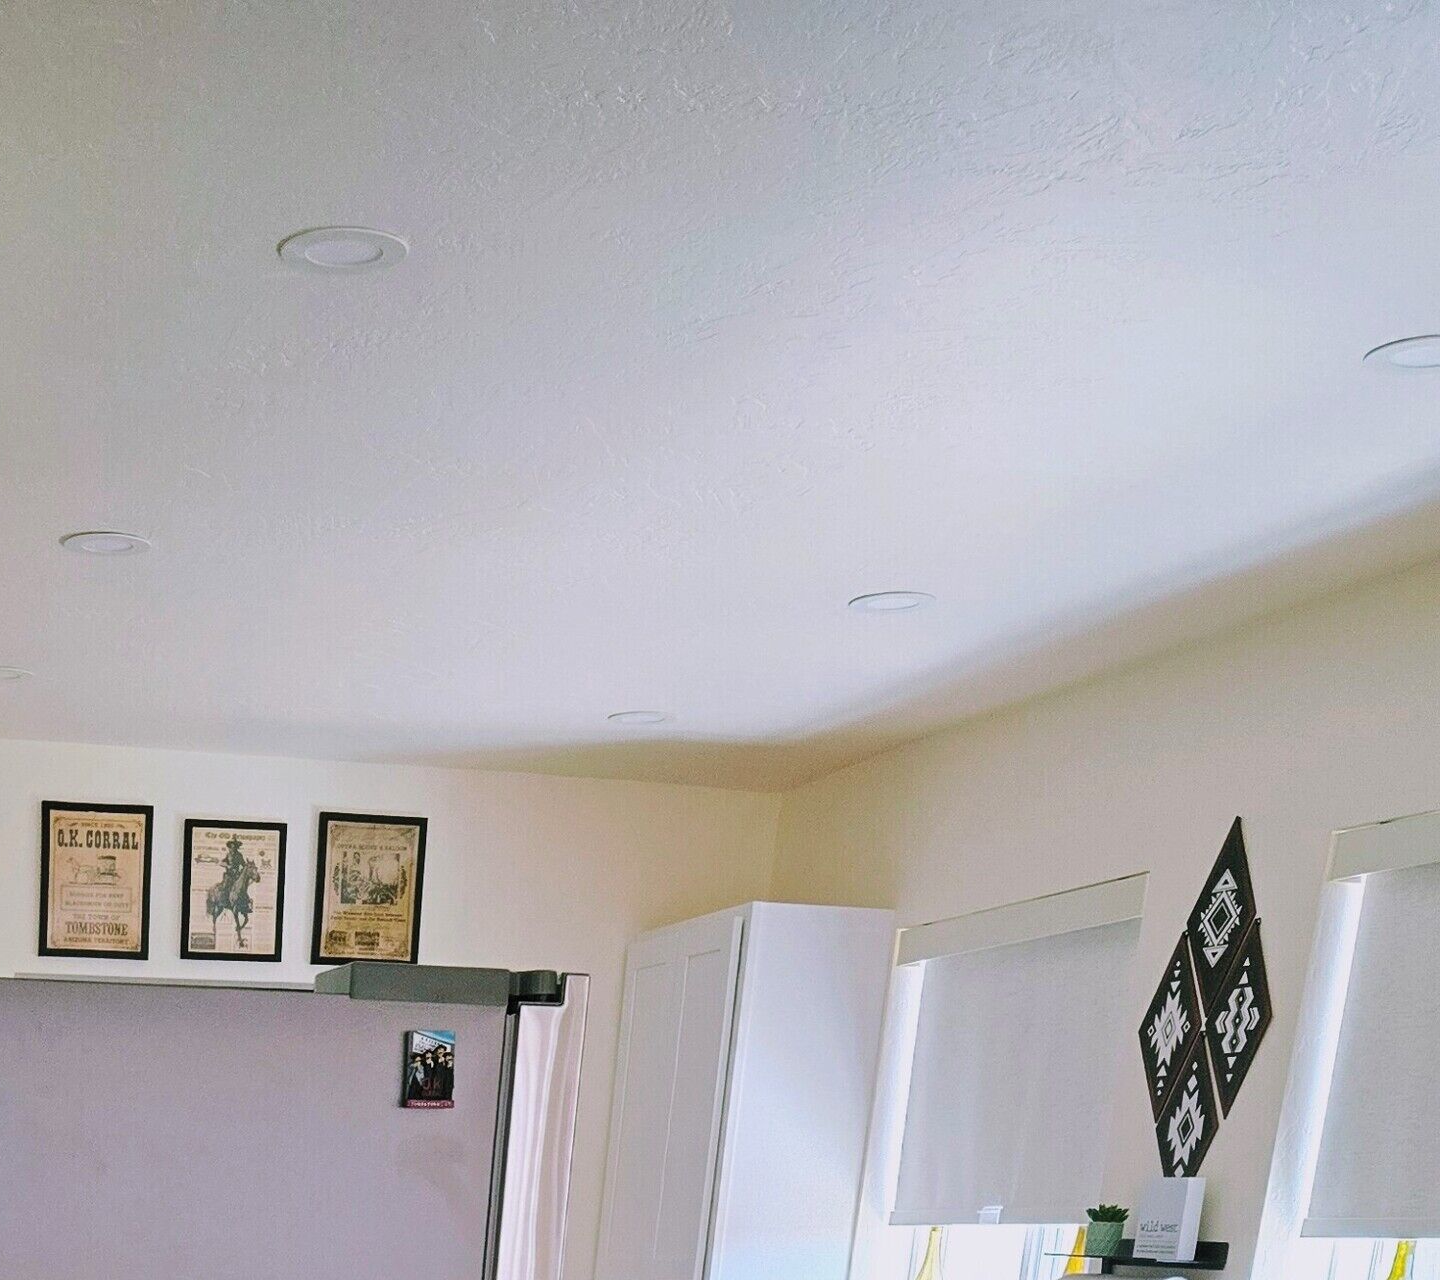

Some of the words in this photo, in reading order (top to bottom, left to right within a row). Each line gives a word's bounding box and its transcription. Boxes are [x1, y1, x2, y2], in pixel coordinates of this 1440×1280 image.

[57, 829, 83, 848] O.K.
[86, 830, 139, 850] CORRAL
[65, 921, 129, 936] TOMBSTONE
[1140, 1220, 1160, 1232] wild
